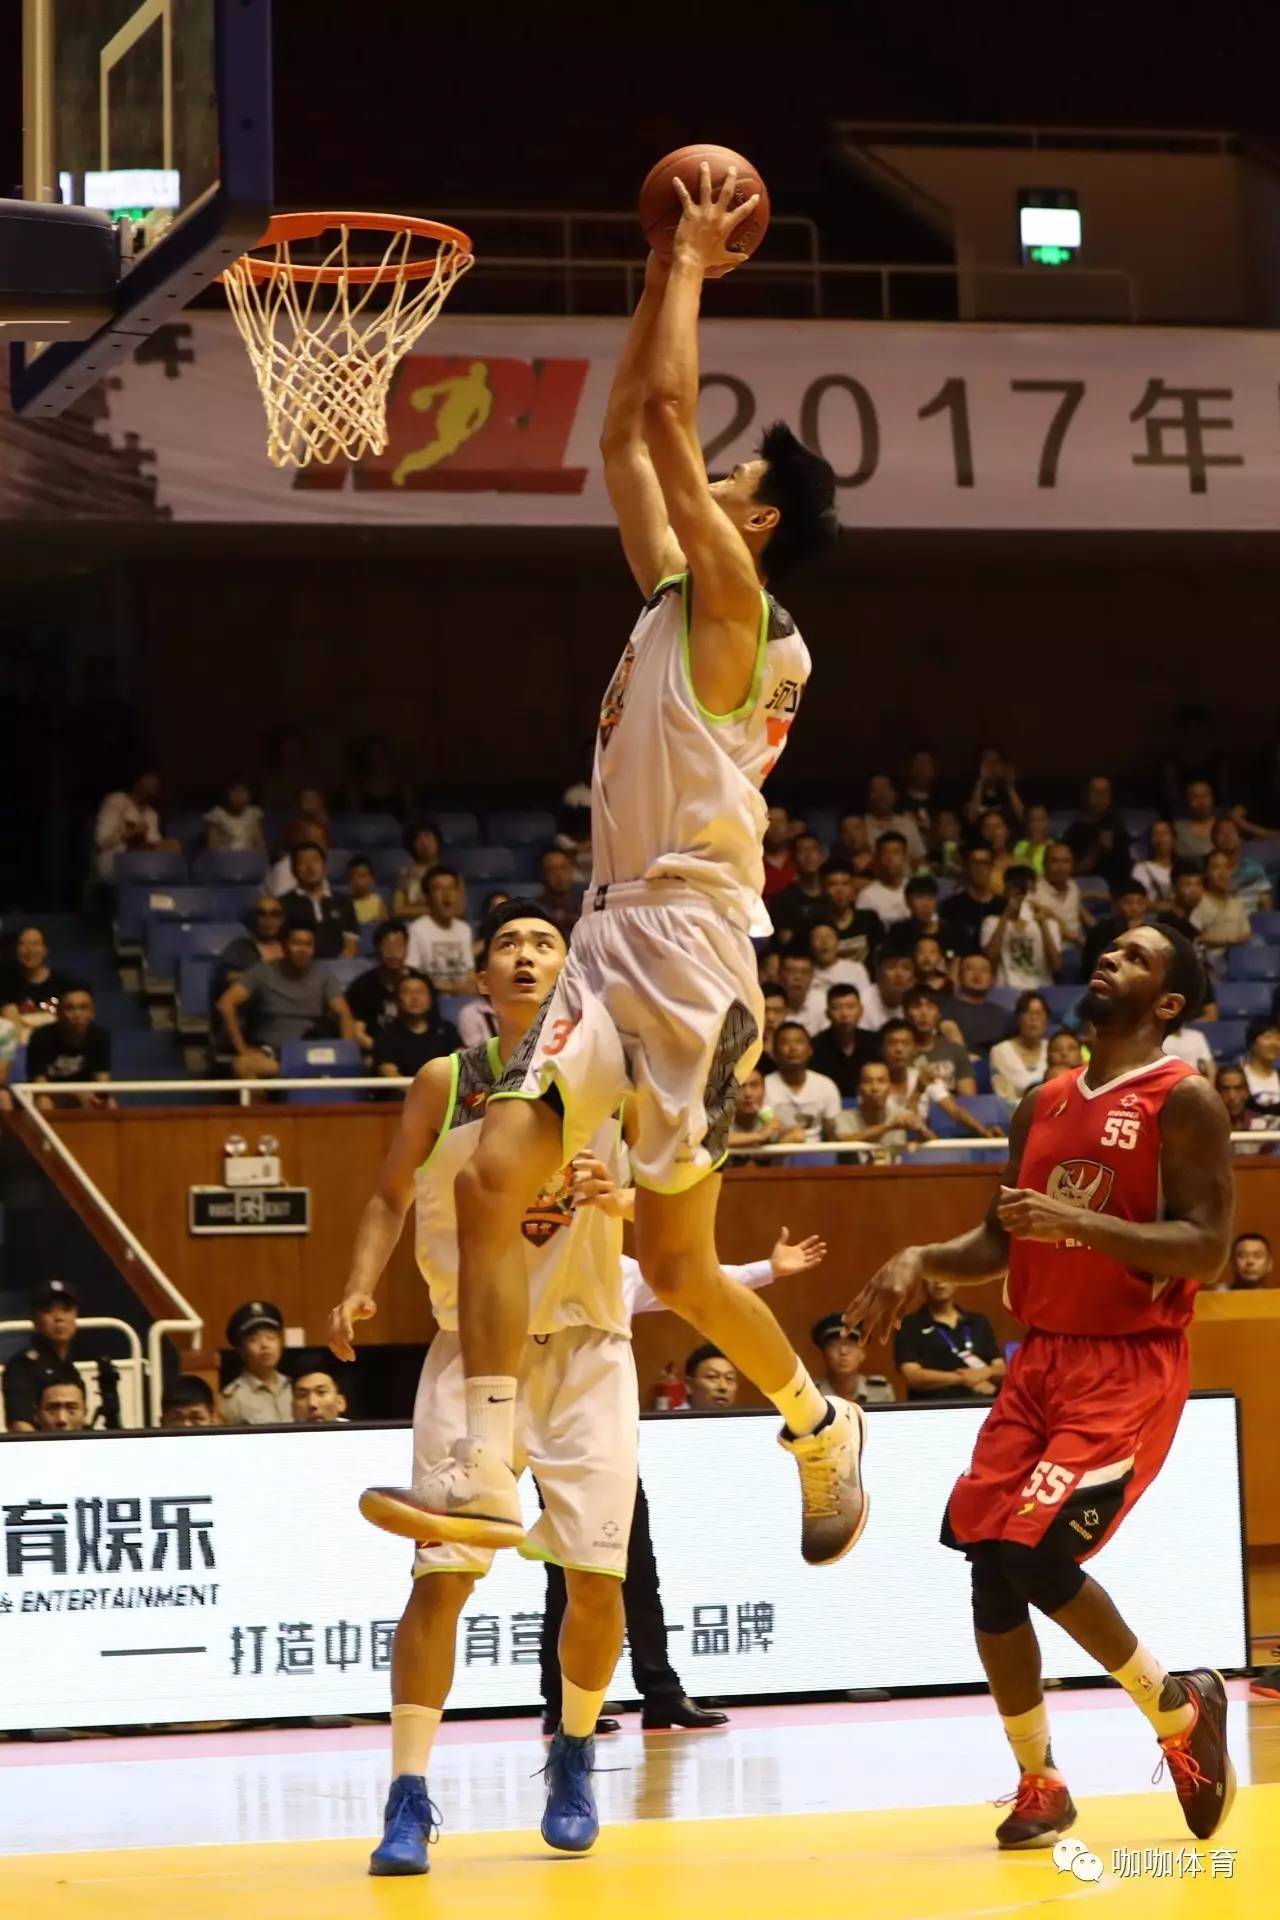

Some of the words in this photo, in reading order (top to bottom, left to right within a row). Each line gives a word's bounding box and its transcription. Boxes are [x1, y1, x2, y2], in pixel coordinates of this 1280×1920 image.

[1100, 1118, 1140, 1150] 55
[1021, 1460, 1075, 1505] 55
[2, 1495, 217, 1576] 育娱乐
[20, 1583, 219, 1612] ENTERTAINMENT
